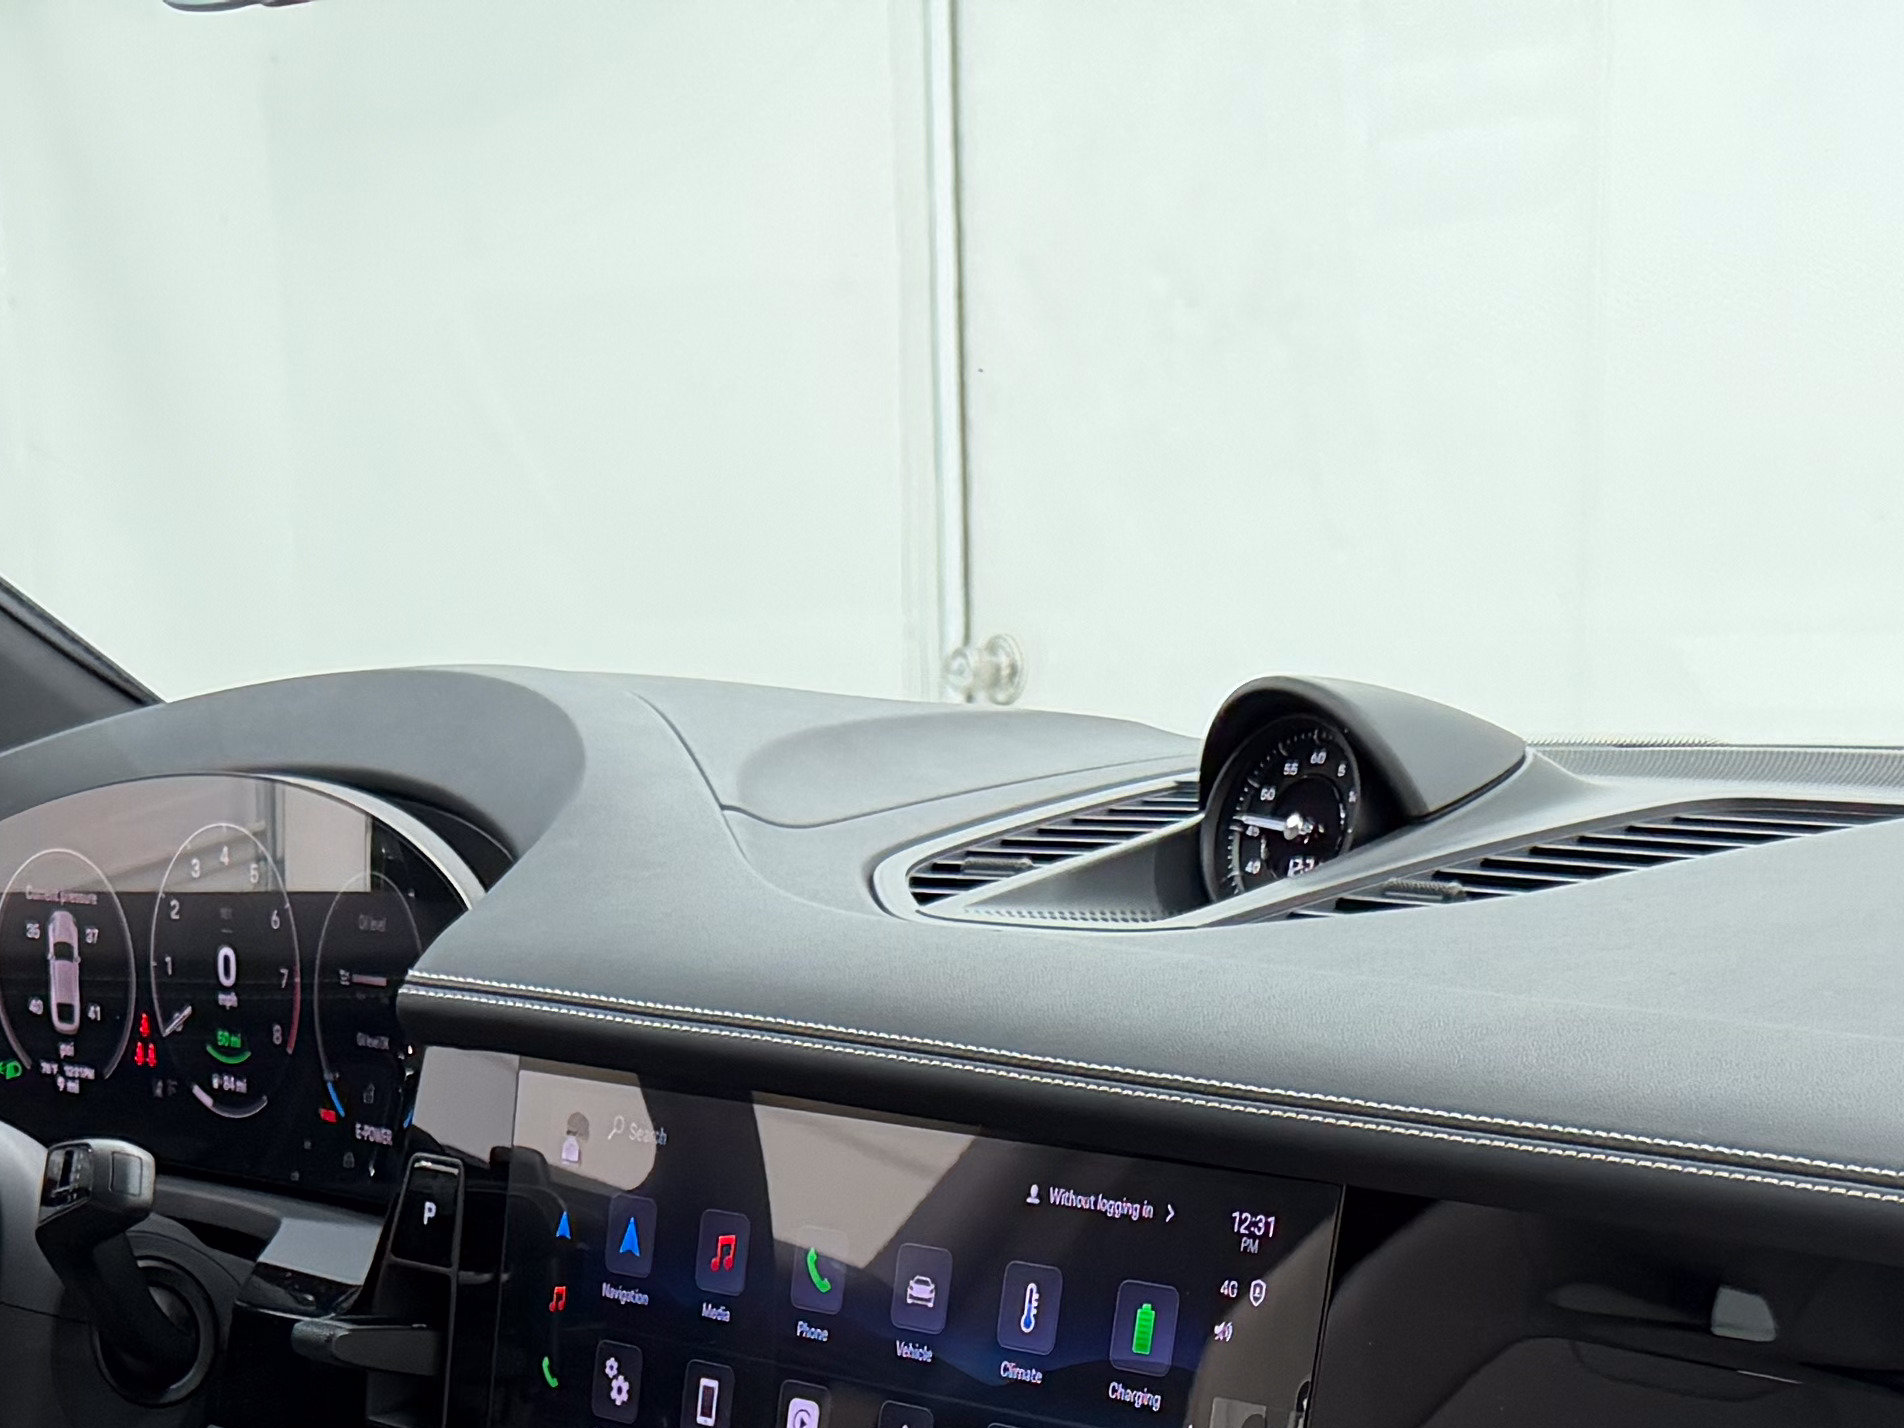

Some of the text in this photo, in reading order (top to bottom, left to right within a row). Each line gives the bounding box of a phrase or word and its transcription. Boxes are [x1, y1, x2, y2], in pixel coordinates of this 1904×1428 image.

[220, 845, 230, 866] 4
[191, 858, 200, 878] 3
[249, 864, 259, 884] 5
[169, 899, 180, 920] 2
[270, 910, 280, 930] 6
[164, 956, 173, 976] 1
[217, 946, 237, 988] 0
[279, 968, 289, 988] 7
[216, 1029, 230, 1047] 50
[272, 1024, 282, 1045] 8
[422, 1200, 437, 1226] P
[1049, 1186, 1154, 1221] Without logging in
[1231, 1210, 1276, 1238] 12:31
[1240, 1237, 1259, 1254] PM
[602, 1282, 649, 1305] Navigation
[1220, 1280, 1238, 1298] 4G
[702, 1302, 730, 1322] Media
[797, 1321, 829, 1342] Phone
[896, 1340, 933, 1363] Vehicle
[1000, 1361, 1043, 1384] Climate
[1108, 1381, 1161, 1411] Charging
